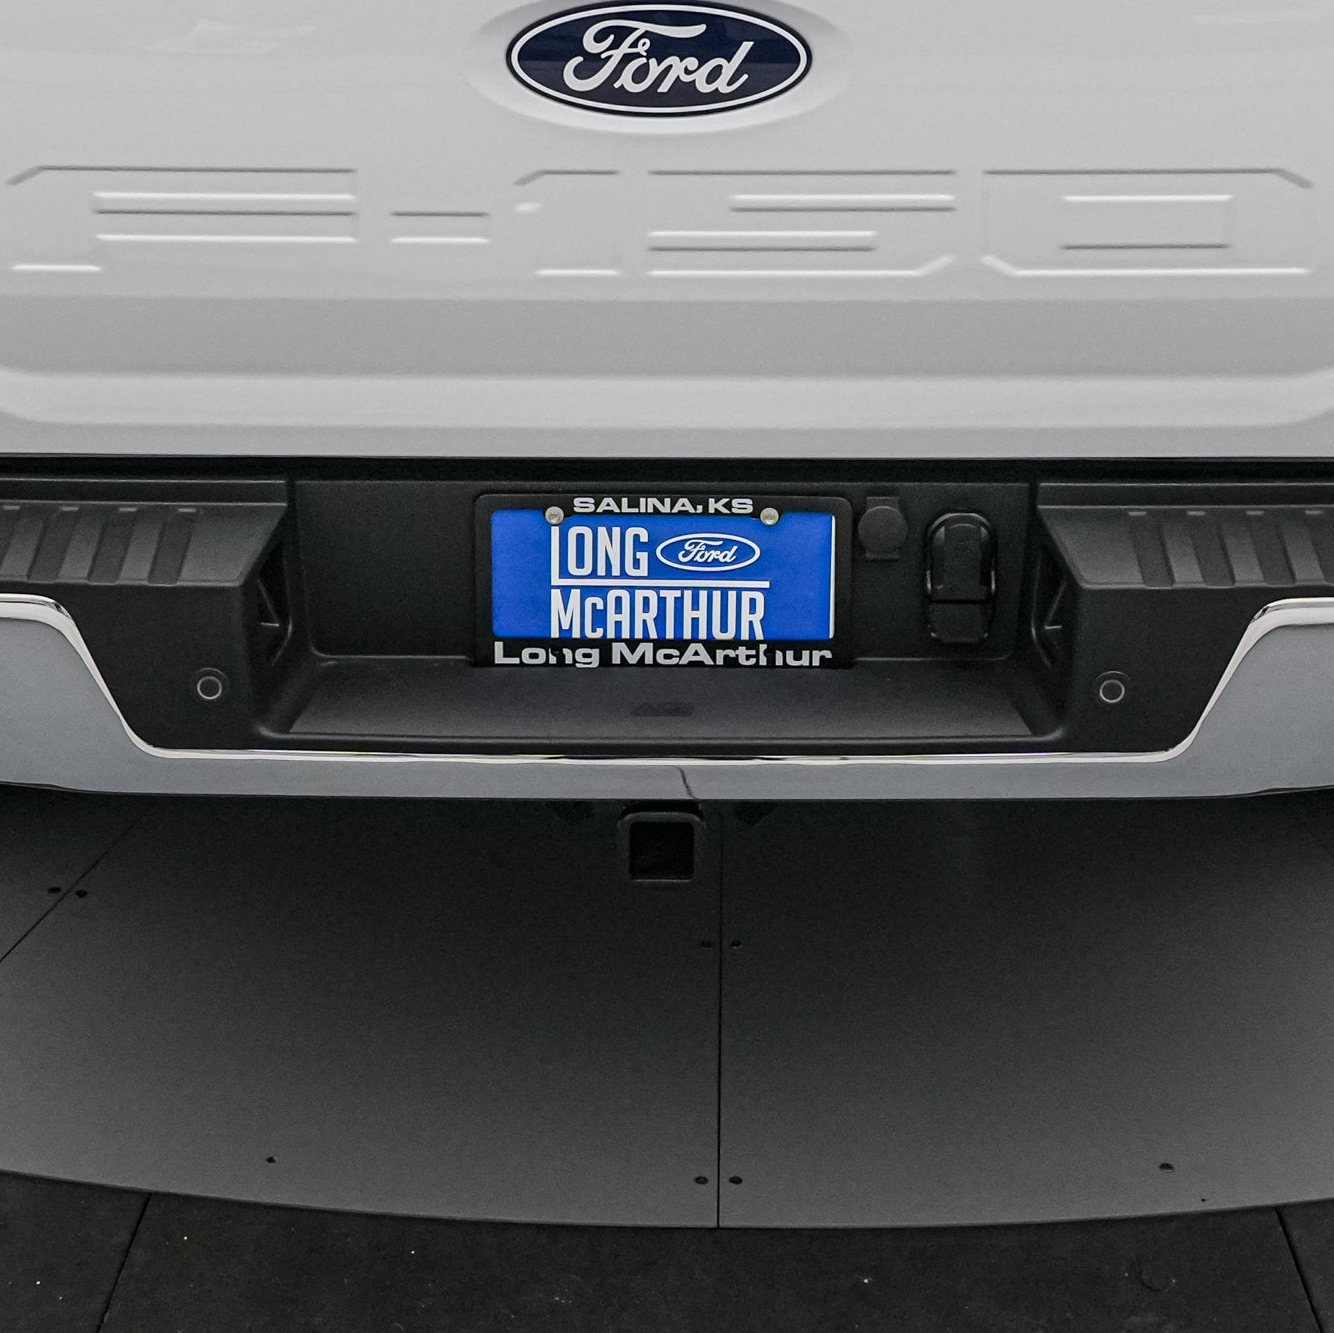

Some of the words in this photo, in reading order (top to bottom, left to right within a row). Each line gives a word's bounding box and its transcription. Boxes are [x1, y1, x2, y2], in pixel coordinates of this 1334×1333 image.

[562, 18, 755, 94] Ford
[573, 497, 703, 514] SALINA,
[708, 498, 754, 514] KS
[550, 525, 649, 586] LONG
[678, 539, 738, 563] Ford
[550, 588, 766, 640] McARTHUR
[494, 642, 600, 668] Long
